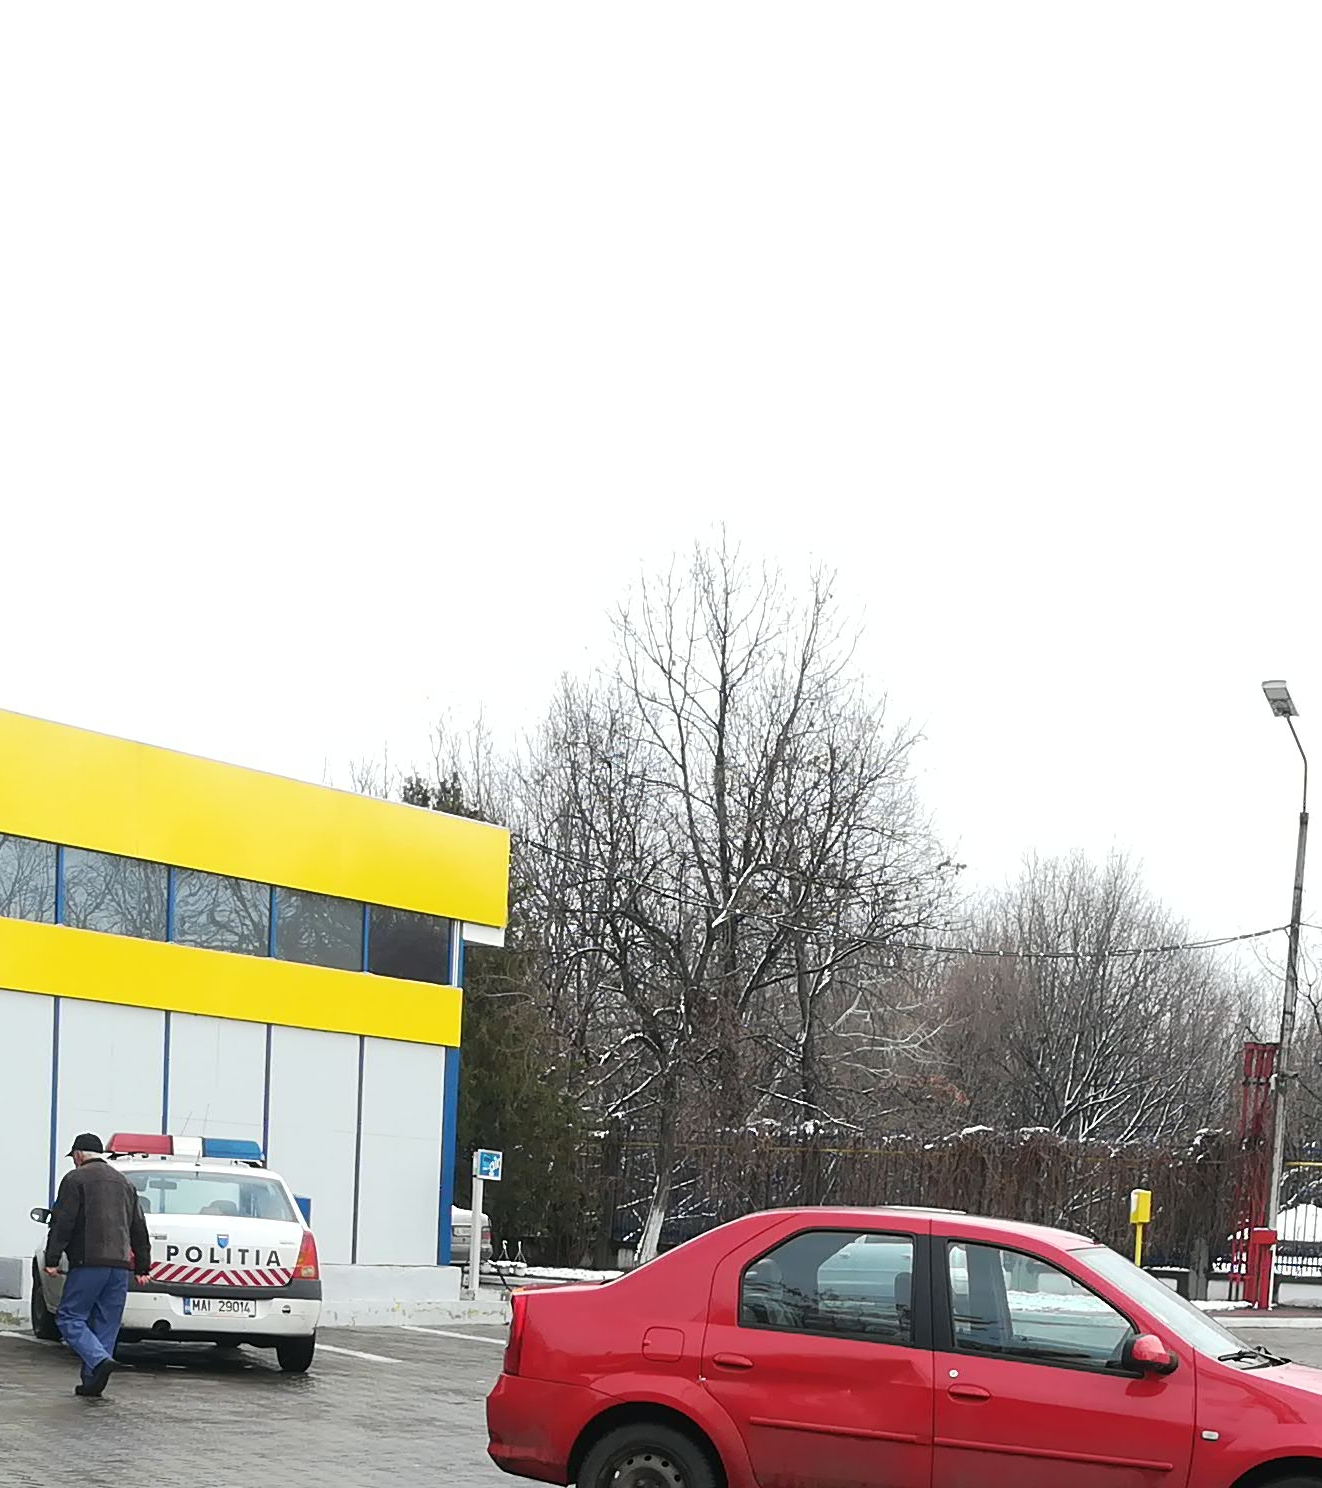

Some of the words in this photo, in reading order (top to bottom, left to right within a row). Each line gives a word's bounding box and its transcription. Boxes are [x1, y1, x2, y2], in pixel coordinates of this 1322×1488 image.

[166, 1245, 281, 1266] POLITIA
[192, 1299, 211, 1312] MAI
[218, 1300, 251, 1313] 29014
